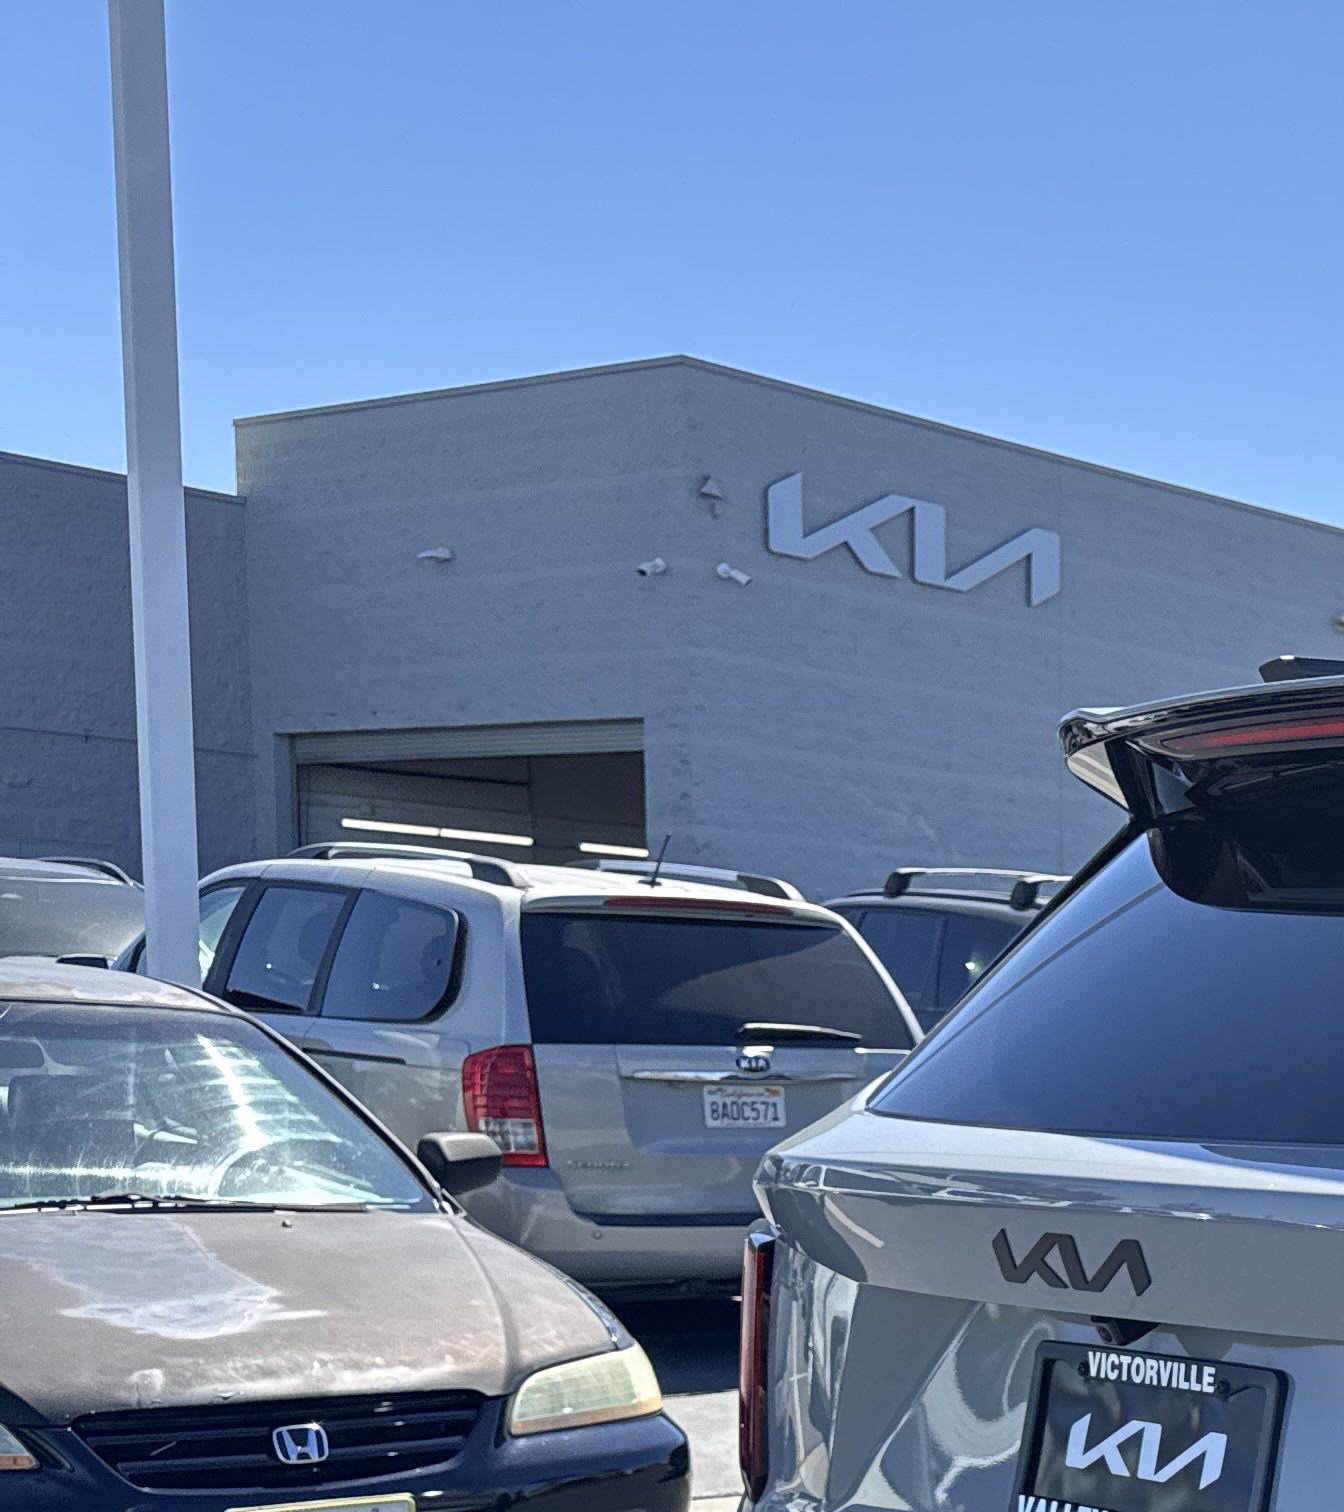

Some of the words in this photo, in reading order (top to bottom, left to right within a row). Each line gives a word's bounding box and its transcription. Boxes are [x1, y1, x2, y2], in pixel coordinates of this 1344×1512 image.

[768, 471, 1060, 608] KIA
[740, 1057, 769, 1072] KIA
[992, 1228, 1152, 1296] KIA
[1087, 1350, 1216, 1394] VICTORVILLE
[1065, 1412, 1228, 1491] KIA
